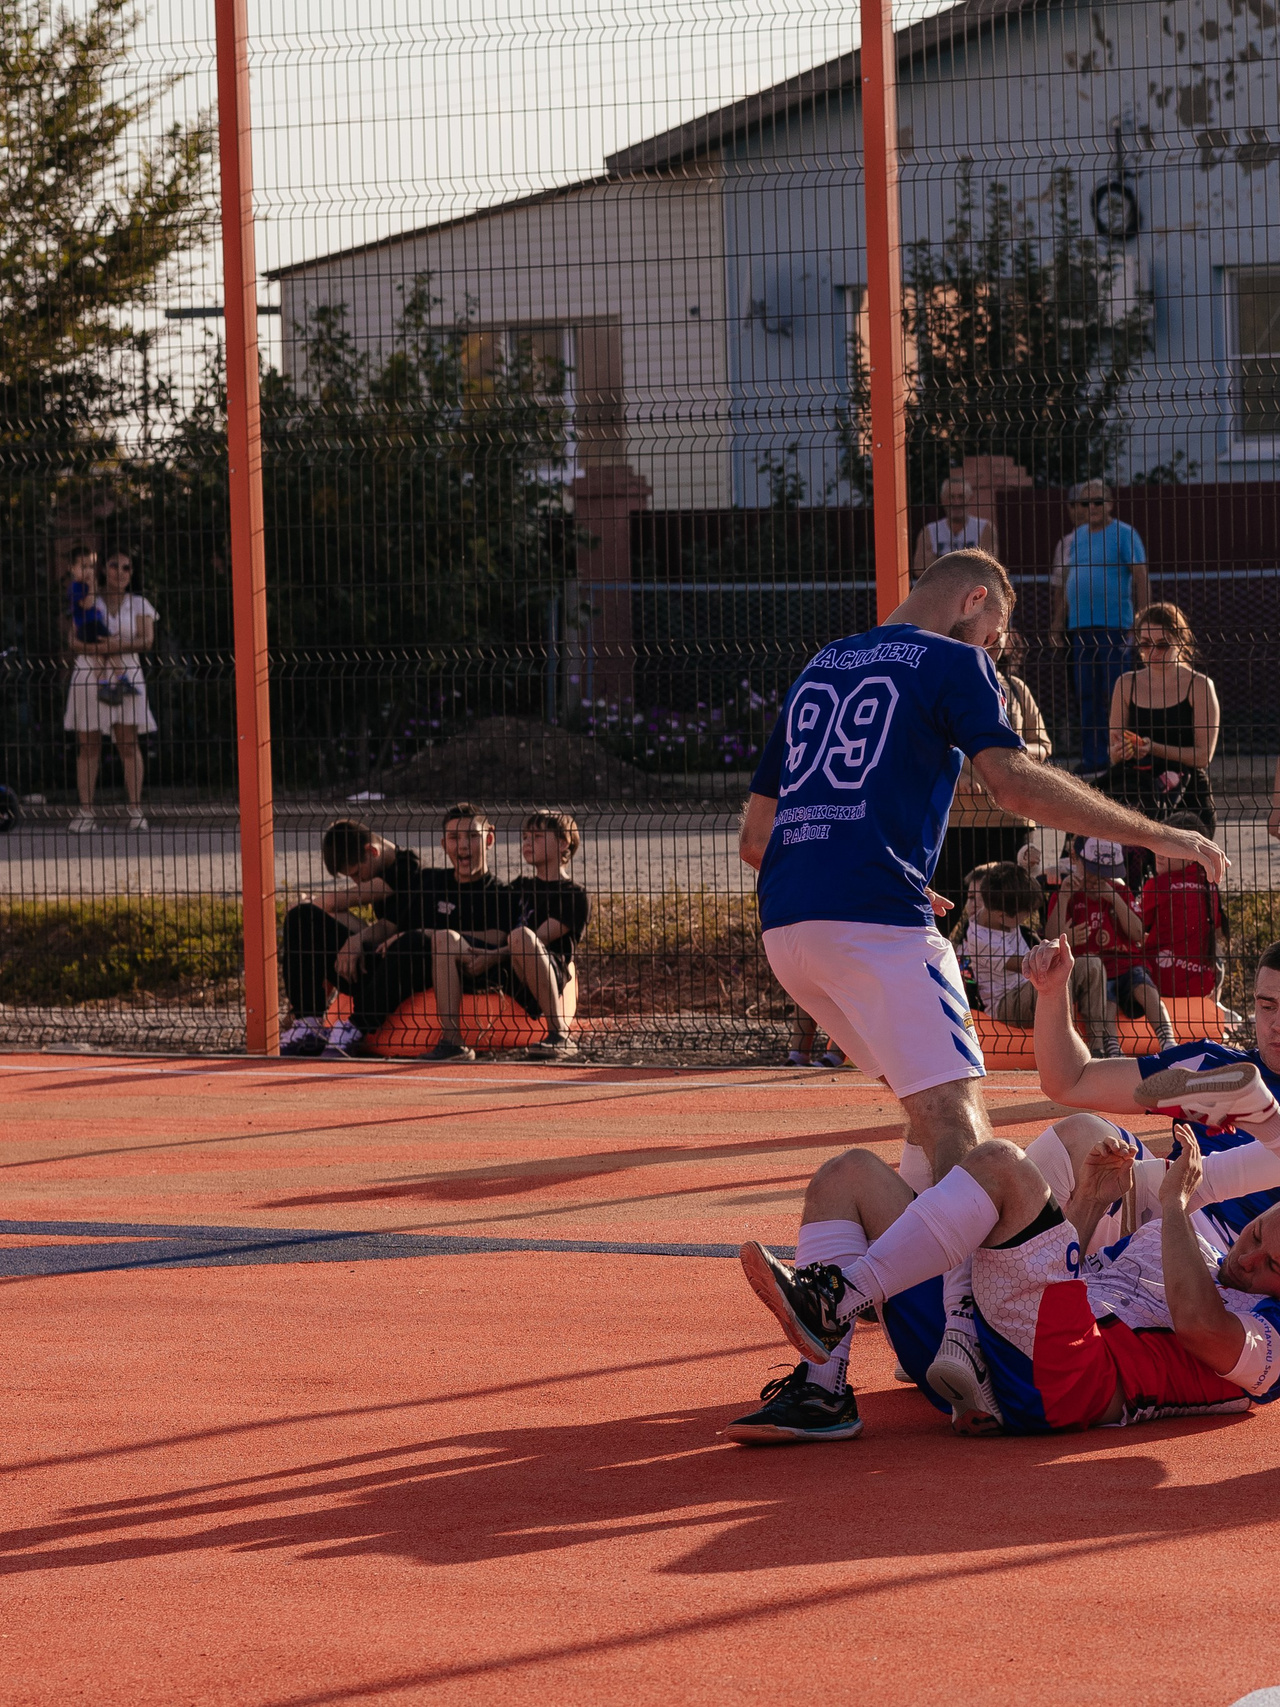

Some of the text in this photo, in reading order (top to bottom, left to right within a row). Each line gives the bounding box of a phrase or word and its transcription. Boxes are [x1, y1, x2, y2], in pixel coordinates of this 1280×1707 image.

[802, 642, 928, 672] АСПИЕЦ
[780, 676, 899, 797] 99
[772, 799, 866, 832] МЫЗЯКСКИЙ
[783, 822, 831, 845] РАЙОН
[1066, 1241, 1080, 1279] 9
[1251, 1364, 1272, 1391] SPORT
